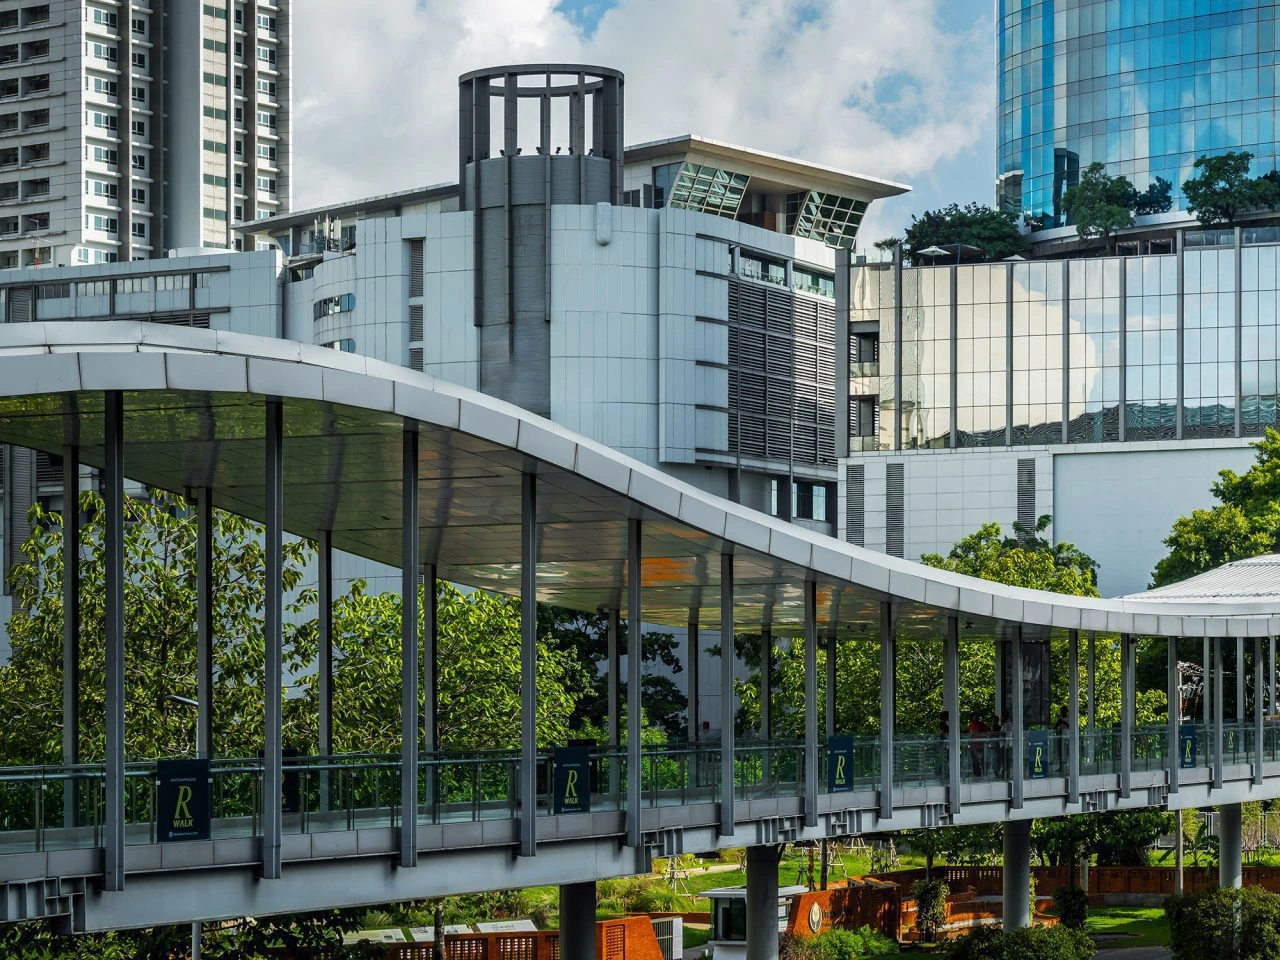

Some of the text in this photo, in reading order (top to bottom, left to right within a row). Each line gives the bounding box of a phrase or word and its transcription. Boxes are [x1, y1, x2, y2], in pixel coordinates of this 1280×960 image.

[836, 755, 846, 779] R
[1035, 747, 1042, 767] R
[565, 770, 578, 797] R
[175, 785, 193, 818] R
[564, 797, 579, 805] WALK
[173, 819, 194, 828] WALK
